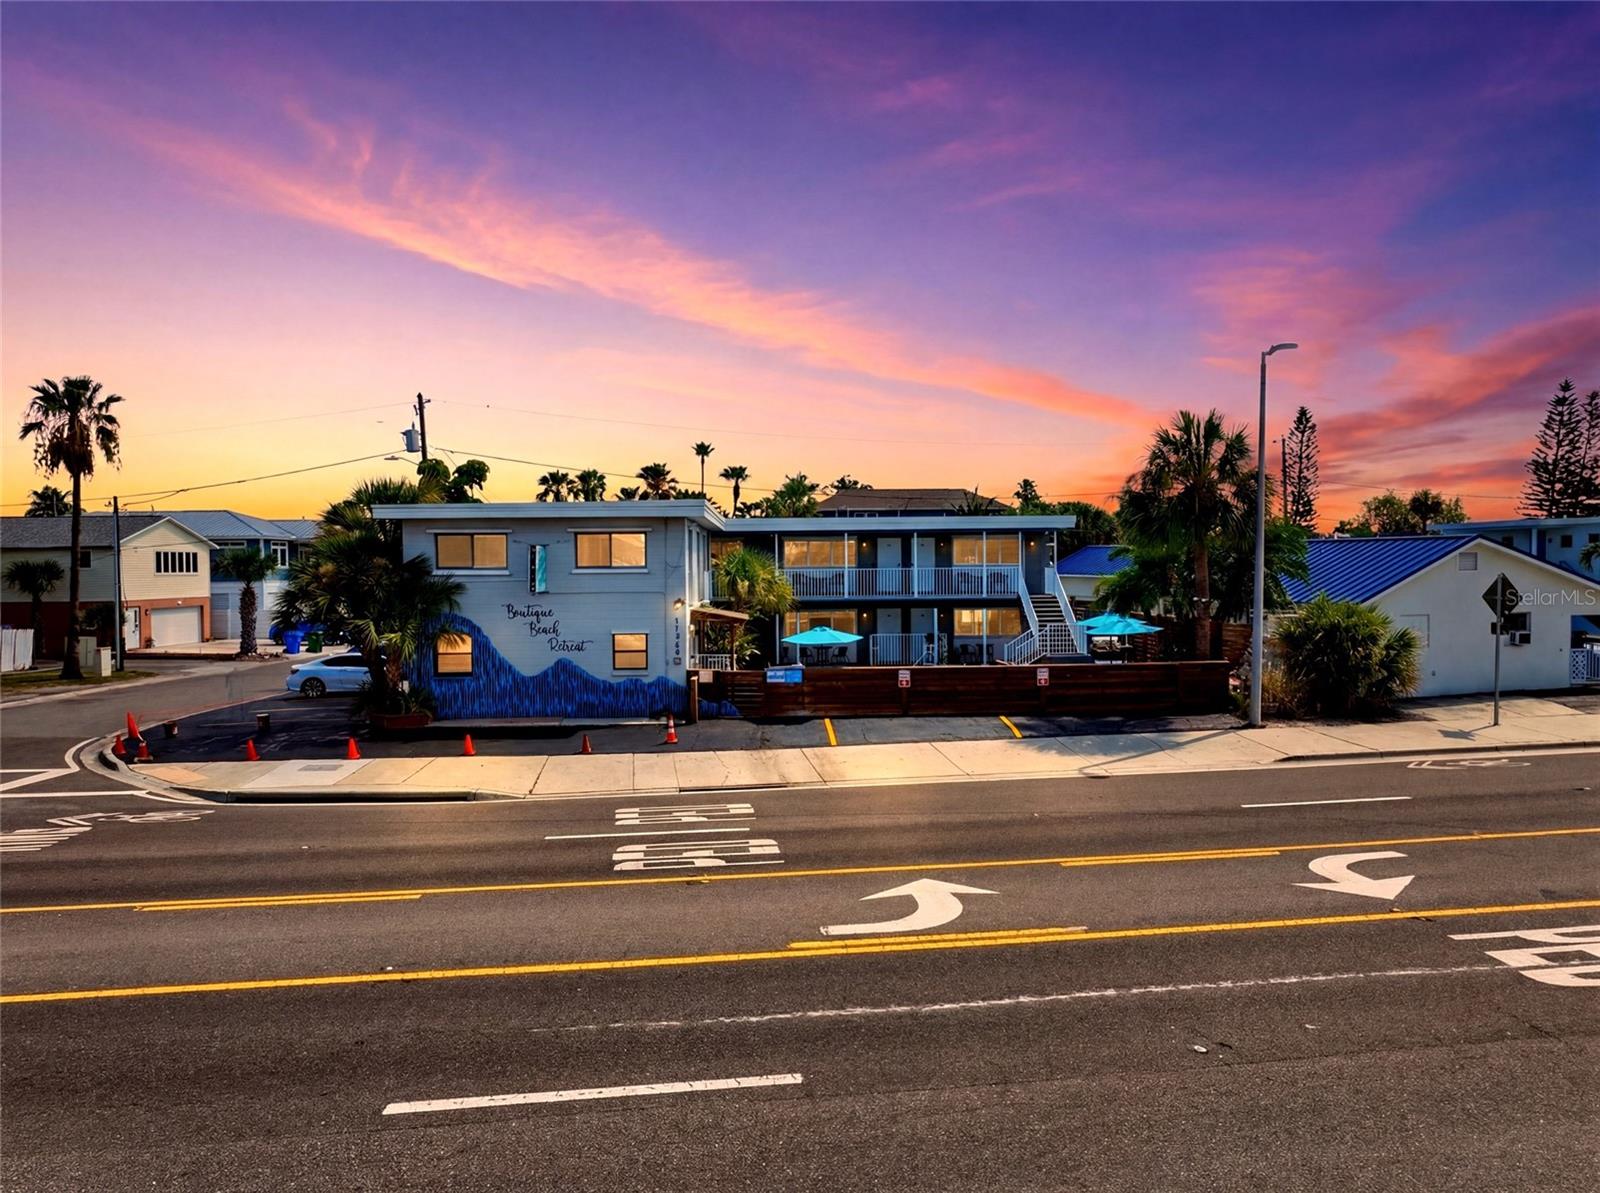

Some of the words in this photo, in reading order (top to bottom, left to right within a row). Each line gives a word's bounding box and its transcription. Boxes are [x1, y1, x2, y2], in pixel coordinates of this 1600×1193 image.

[502, 603, 554, 623] Boutique
[523, 620, 561, 637] Beach
[547, 637, 594, 652] Retreat
